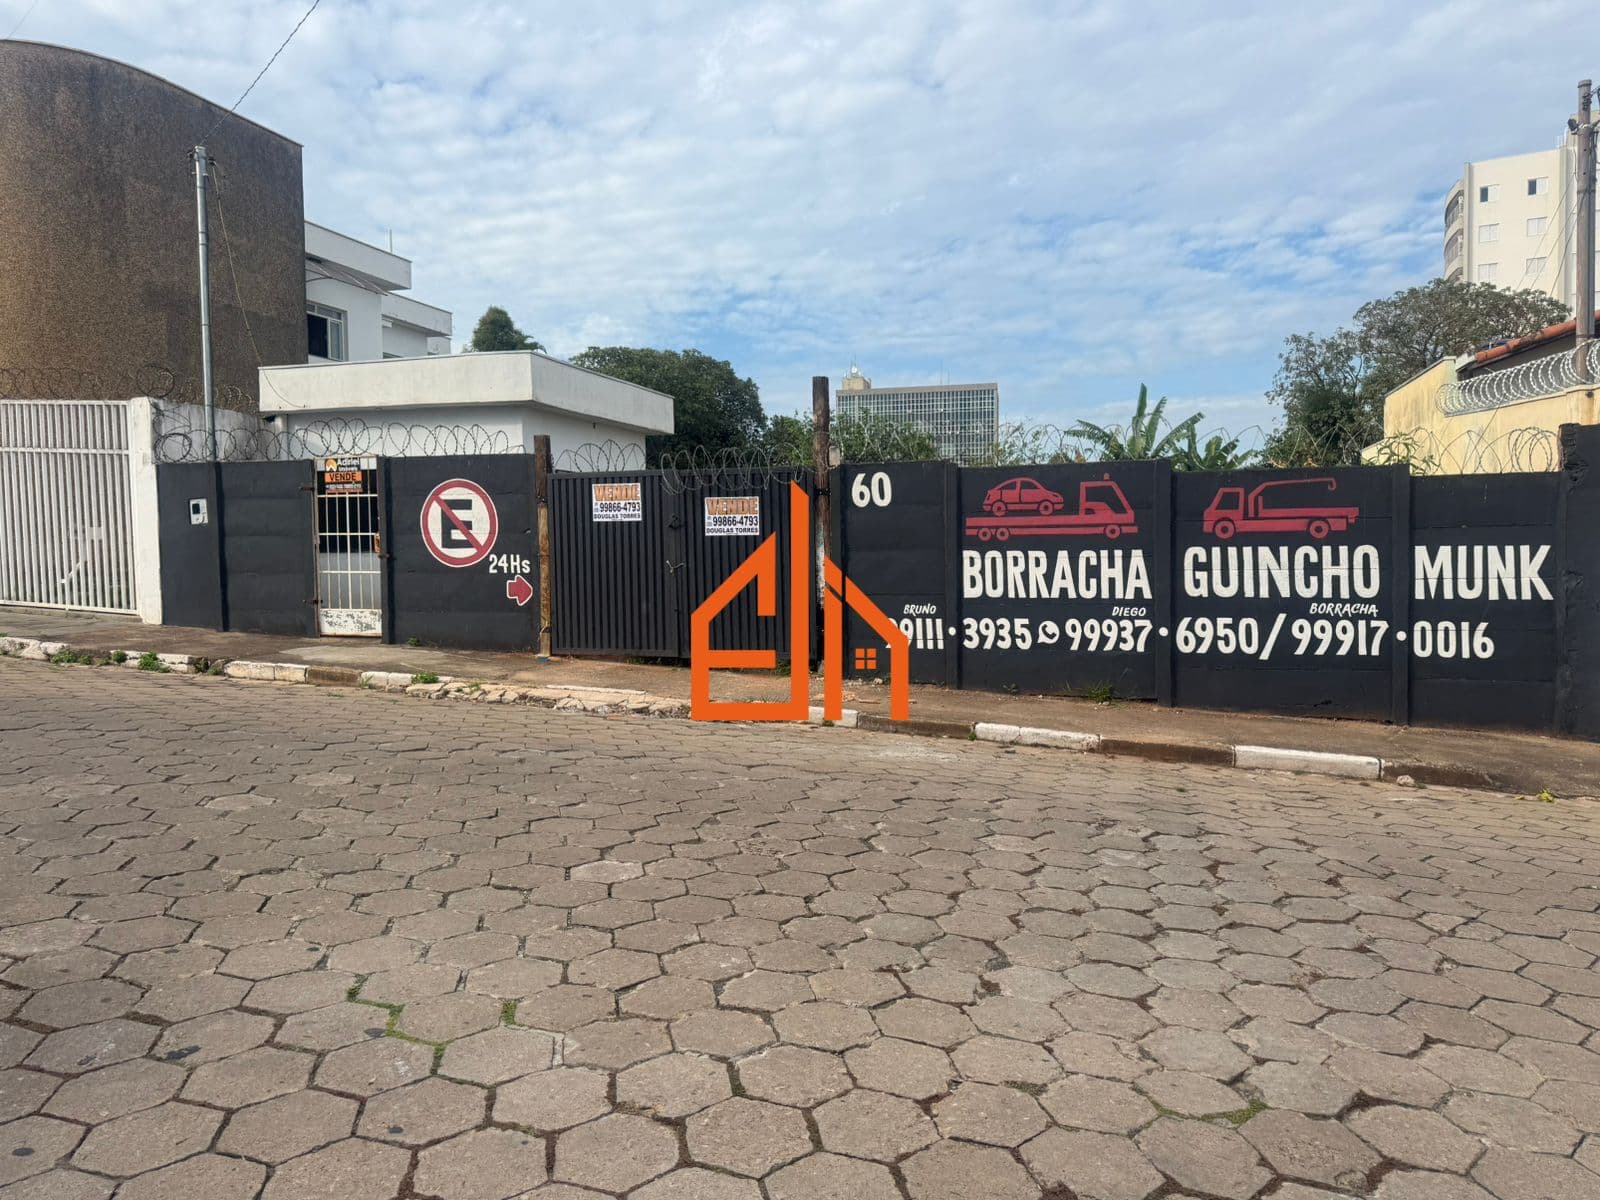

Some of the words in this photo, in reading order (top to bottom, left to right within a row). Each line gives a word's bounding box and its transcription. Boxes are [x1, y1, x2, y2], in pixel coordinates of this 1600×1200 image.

[329, 472, 358, 481] VENDE
[594, 484, 641, 501] VENDE
[851, 471, 892, 508] 60
[600, 502, 641, 512] 99866-4793
[707, 498, 758, 515] VENDE
[713, 516, 758, 526] 99866-4793
[489, 554, 531, 574] 24Hs
[962, 549, 1153, 600] BORRACHA
[1184, 545, 1379, 599] GUINCHO
[1414, 545, 1554, 600] MUNK
[903, 603, 937, 616] BRUNO
[1112, 606, 1147, 617] DIEGO
[1309, 603, 1379, 617] BORRACHA
